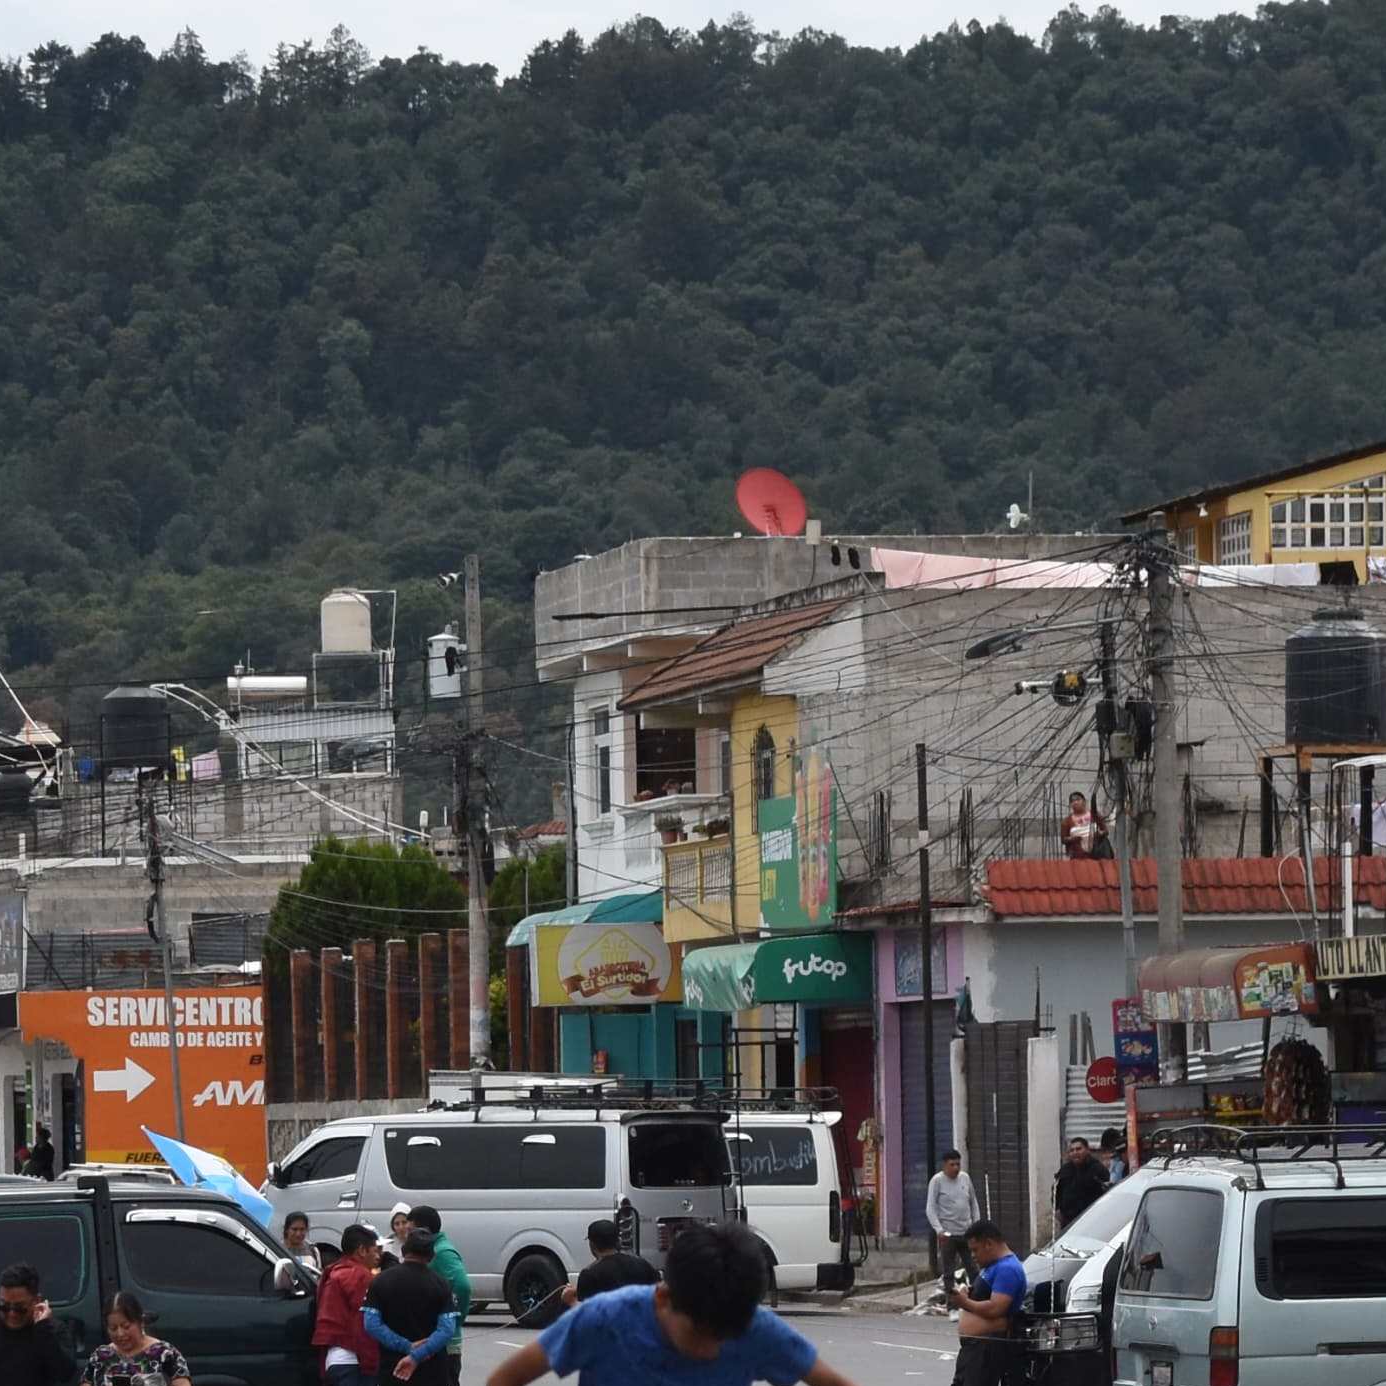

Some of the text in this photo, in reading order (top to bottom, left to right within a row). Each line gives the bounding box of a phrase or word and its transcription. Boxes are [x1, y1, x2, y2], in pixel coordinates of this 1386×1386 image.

[782, 953, 847, 984] frutop
[129, 1031, 185, 1047] CAMBO
[187, 1031, 205, 1047] DE
[207, 1031, 253, 1047] ACEITE
